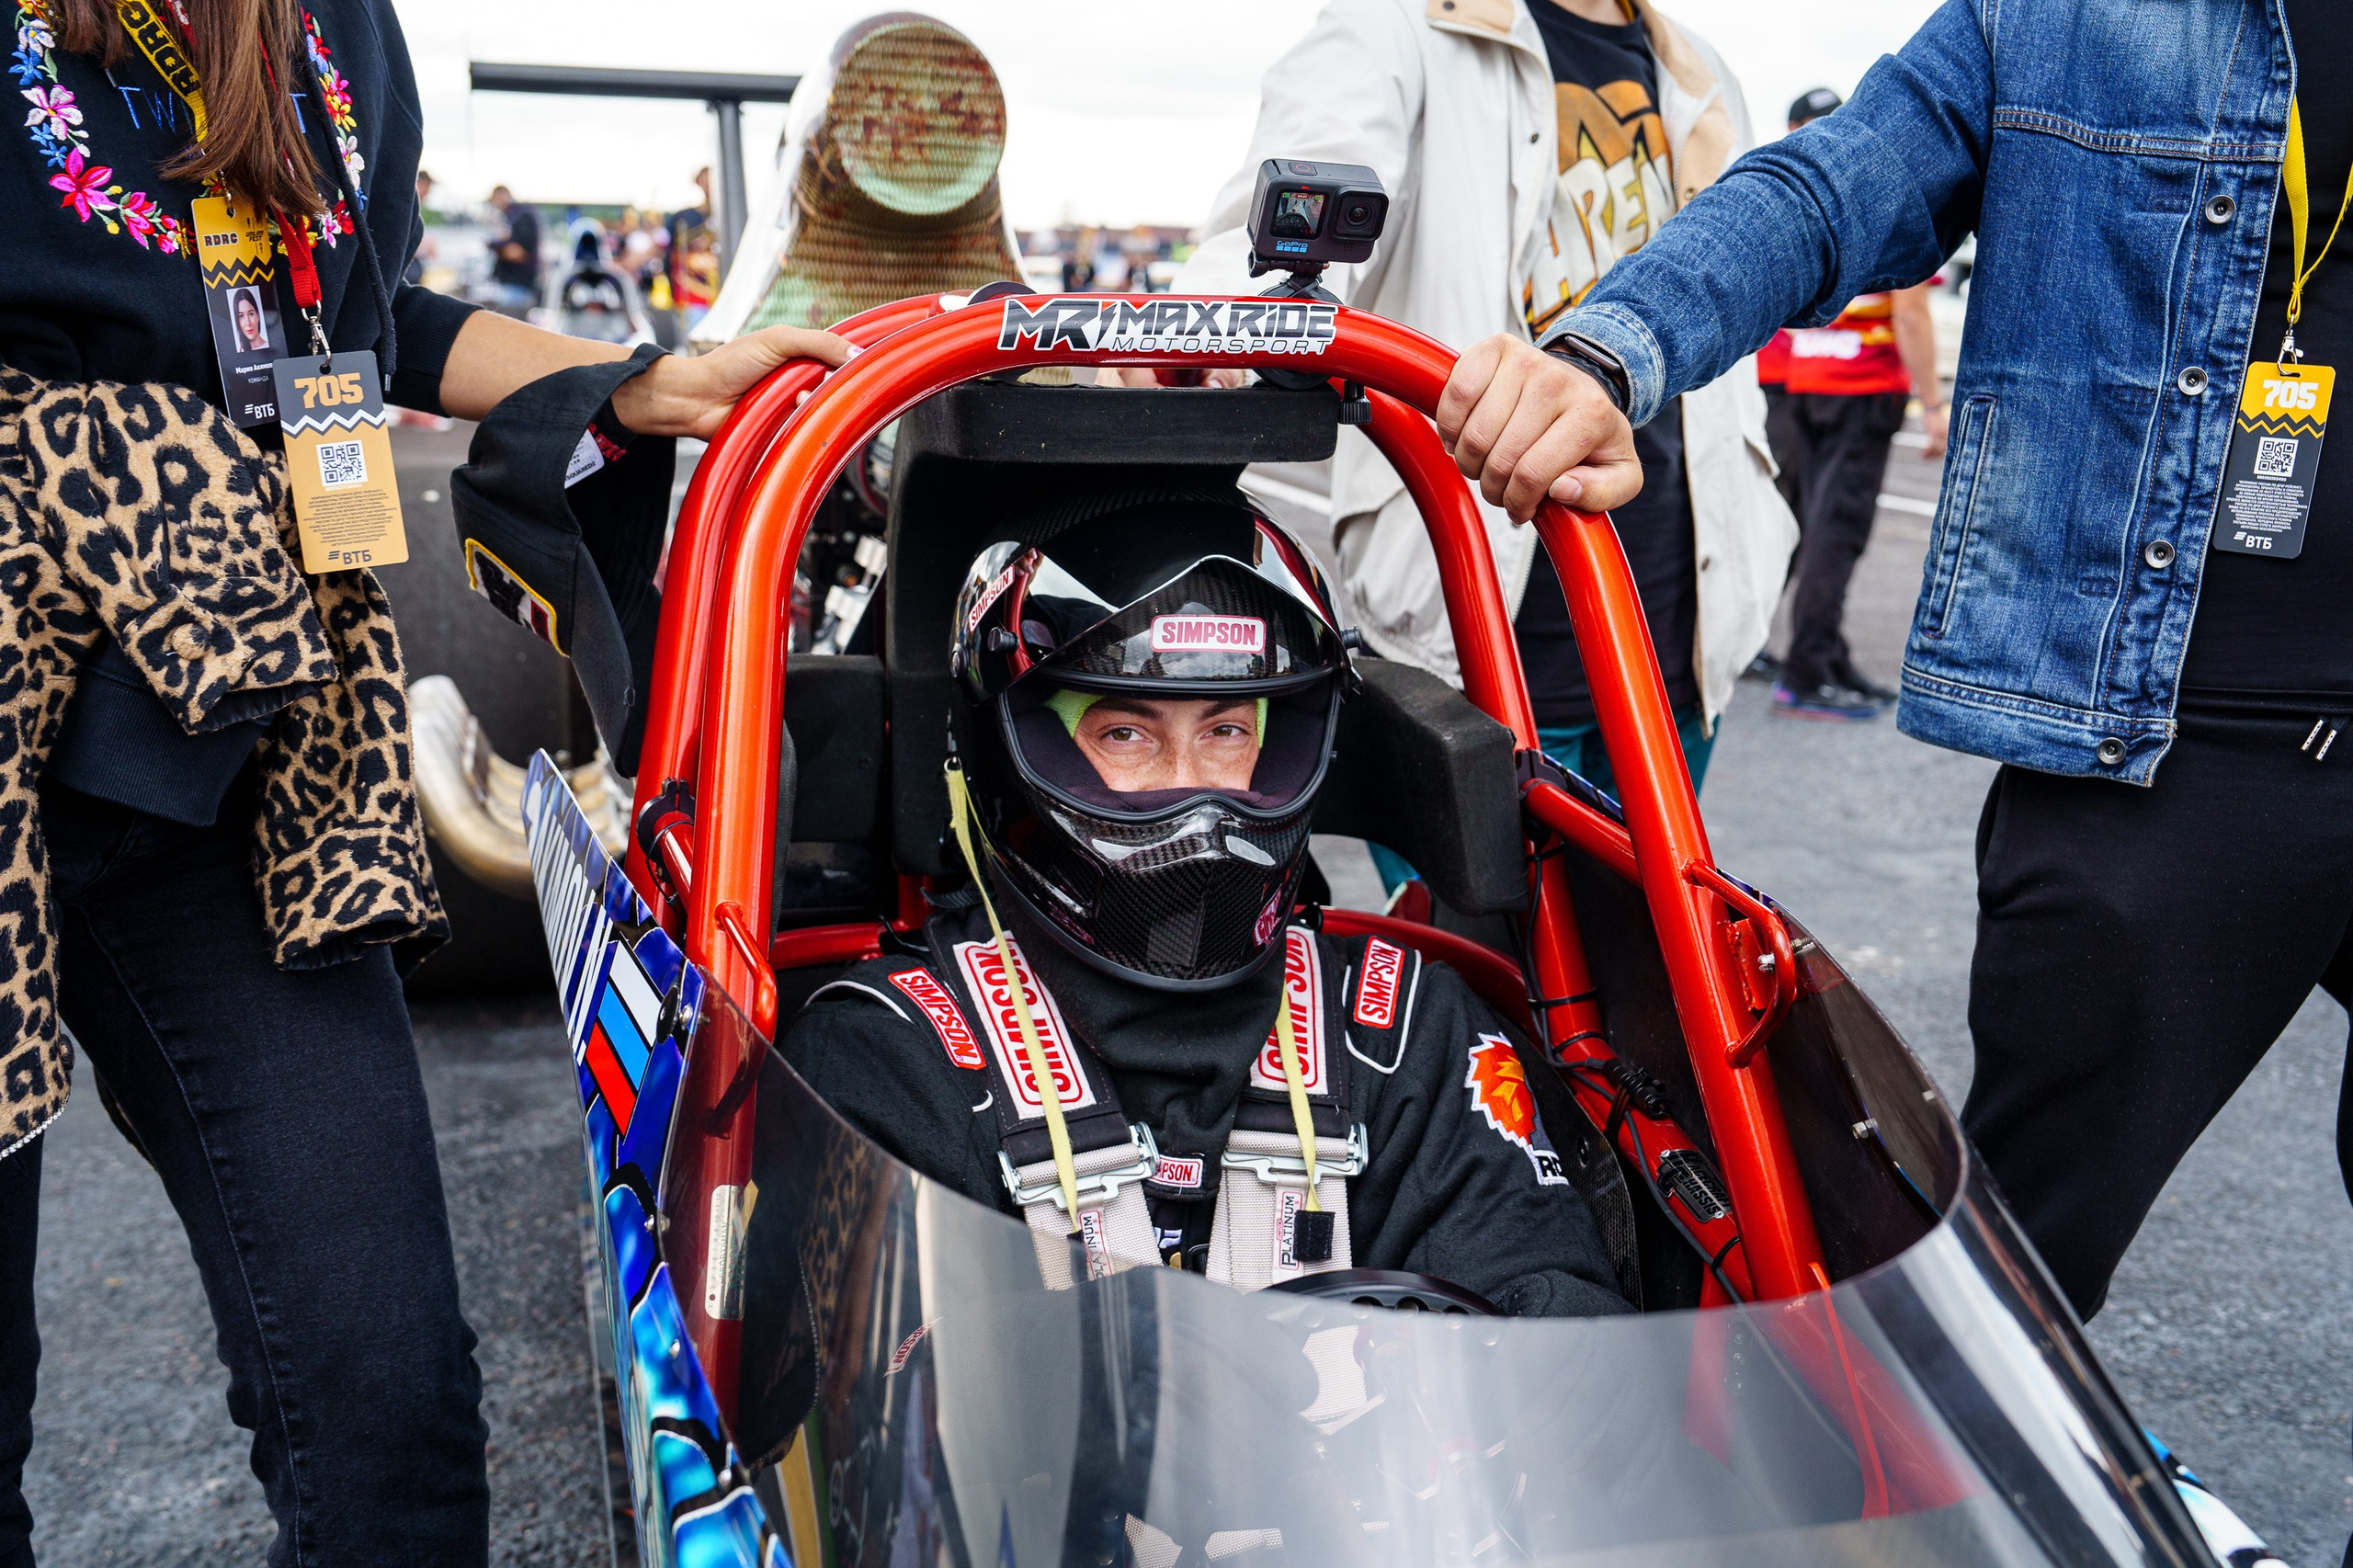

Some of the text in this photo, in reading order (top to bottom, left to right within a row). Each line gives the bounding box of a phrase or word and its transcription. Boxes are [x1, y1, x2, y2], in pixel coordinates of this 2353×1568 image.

[203, 232, 238, 247] RDRC
[1276, 240, 1309, 248] GoPro
[1111, 336, 1331, 353] MOTORSPORT
[294, 372, 364, 409] 705
[2262, 380, 2319, 410] 705
[254, 403, 276, 419] ВТБ
[564, 460, 596, 481] SQUARED2
[2245, 535, 2273, 550] ВТБ
[343, 549, 372, 565] ВТБ
[971, 571, 1009, 627] SIMPSON
[1162, 621, 1256, 646] SIMPSON
[1361, 944, 1400, 1020] SIMPSON
[902, 975, 978, 1061] SIMPSON
[1281, 1196, 1296, 1267] PLATINUM
